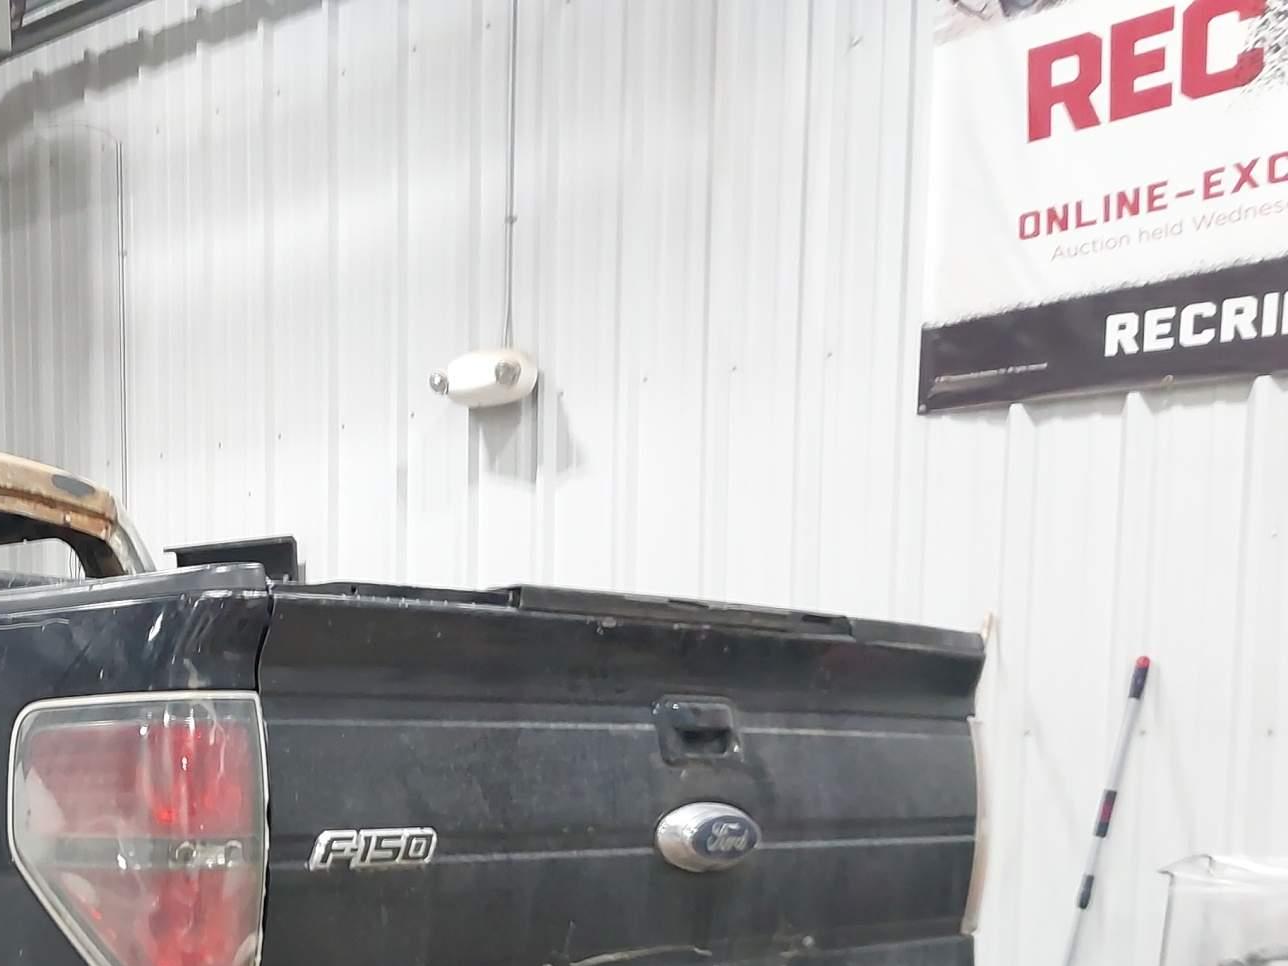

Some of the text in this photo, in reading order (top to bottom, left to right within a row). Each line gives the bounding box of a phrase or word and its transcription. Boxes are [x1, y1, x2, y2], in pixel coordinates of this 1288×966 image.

[1051, 198, 1288, 262] Auction held Wednes
[1104, 291, 1288, 357] RECRI
[309, 827, 438, 872] F-150
